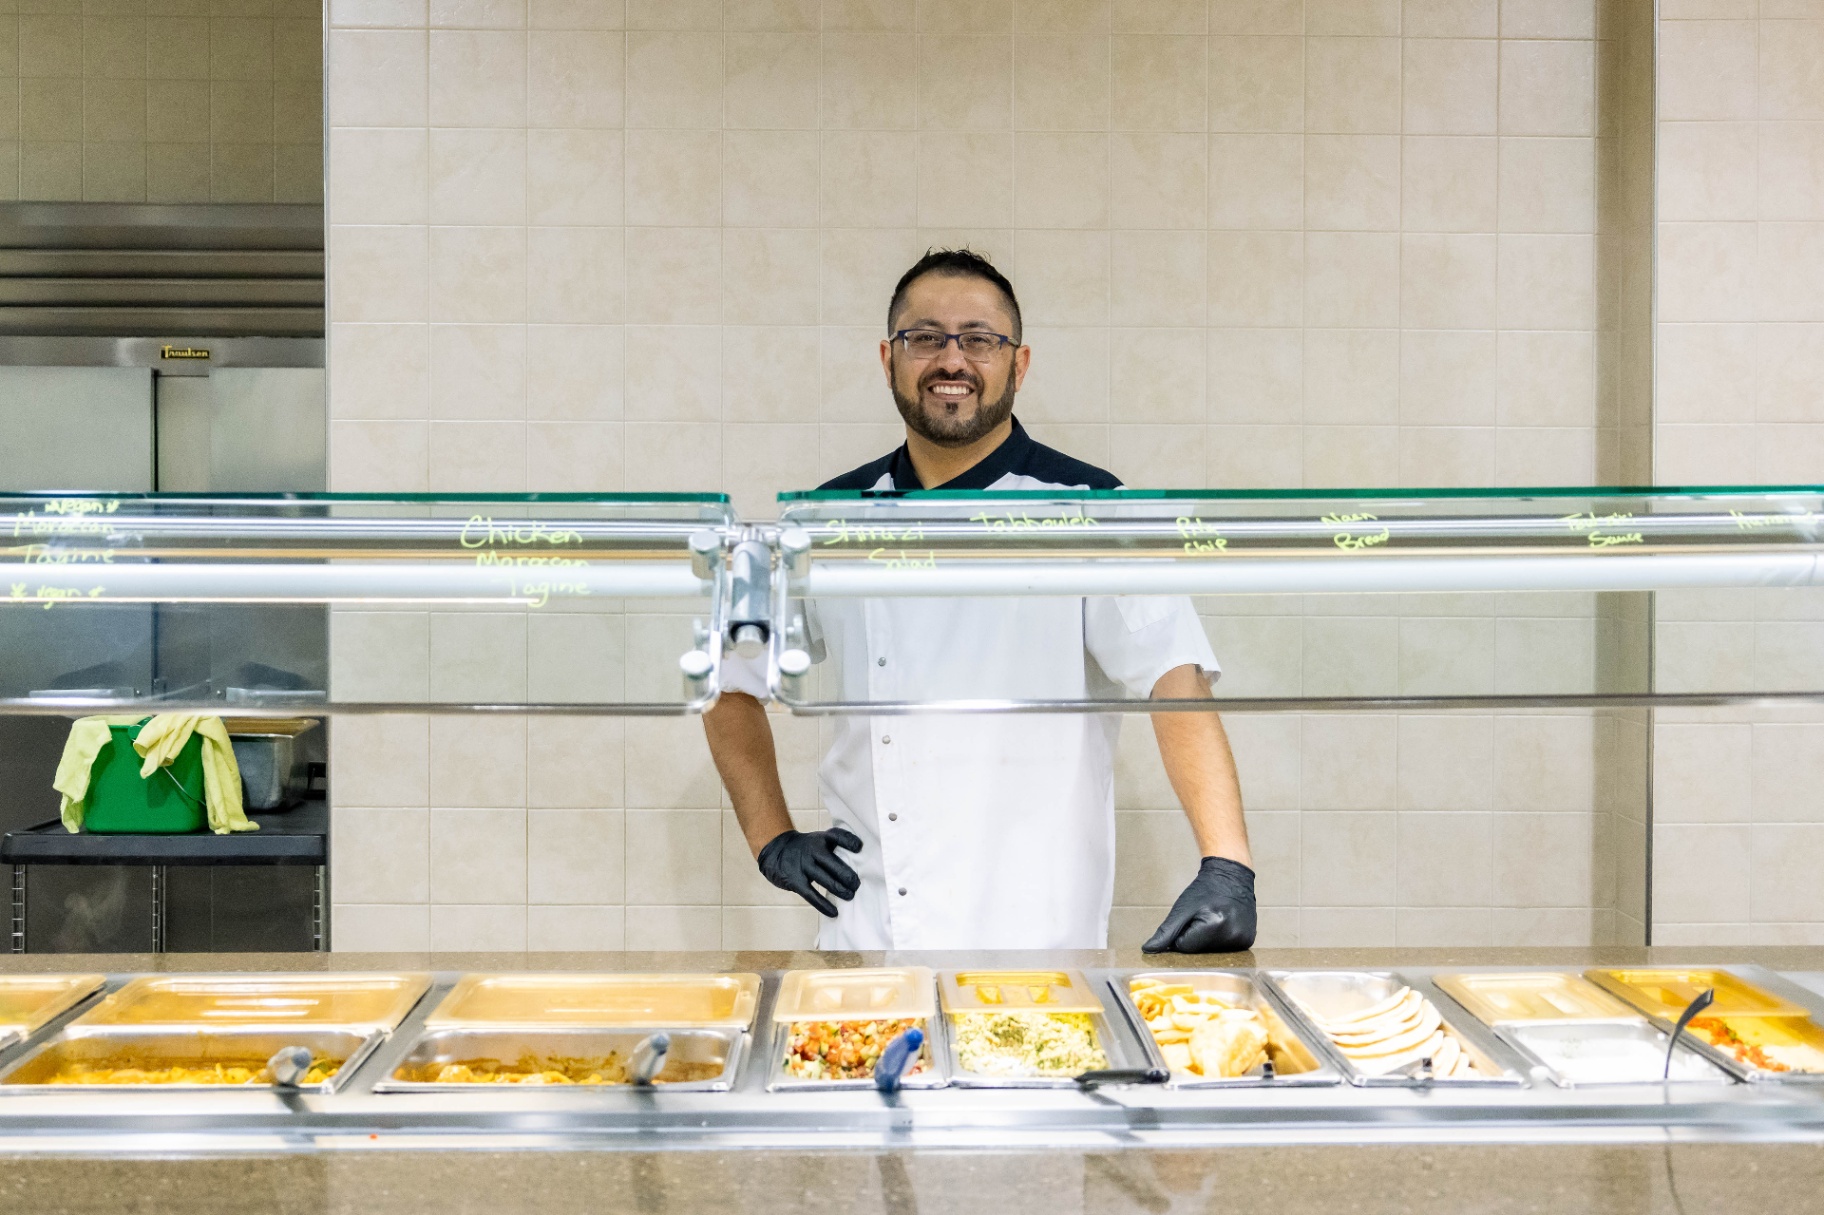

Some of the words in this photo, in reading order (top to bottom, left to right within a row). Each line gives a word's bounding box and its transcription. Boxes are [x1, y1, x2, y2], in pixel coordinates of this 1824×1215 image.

[161, 345, 209, 358] Traulsen
[460, 514, 583, 548] Chicken
[970, 512, 1100, 533] Tabbouleh
[1334, 527, 1389, 552] Bread
[868, 548, 937, 570] Salad
[490, 579, 592, 608] Tagine
